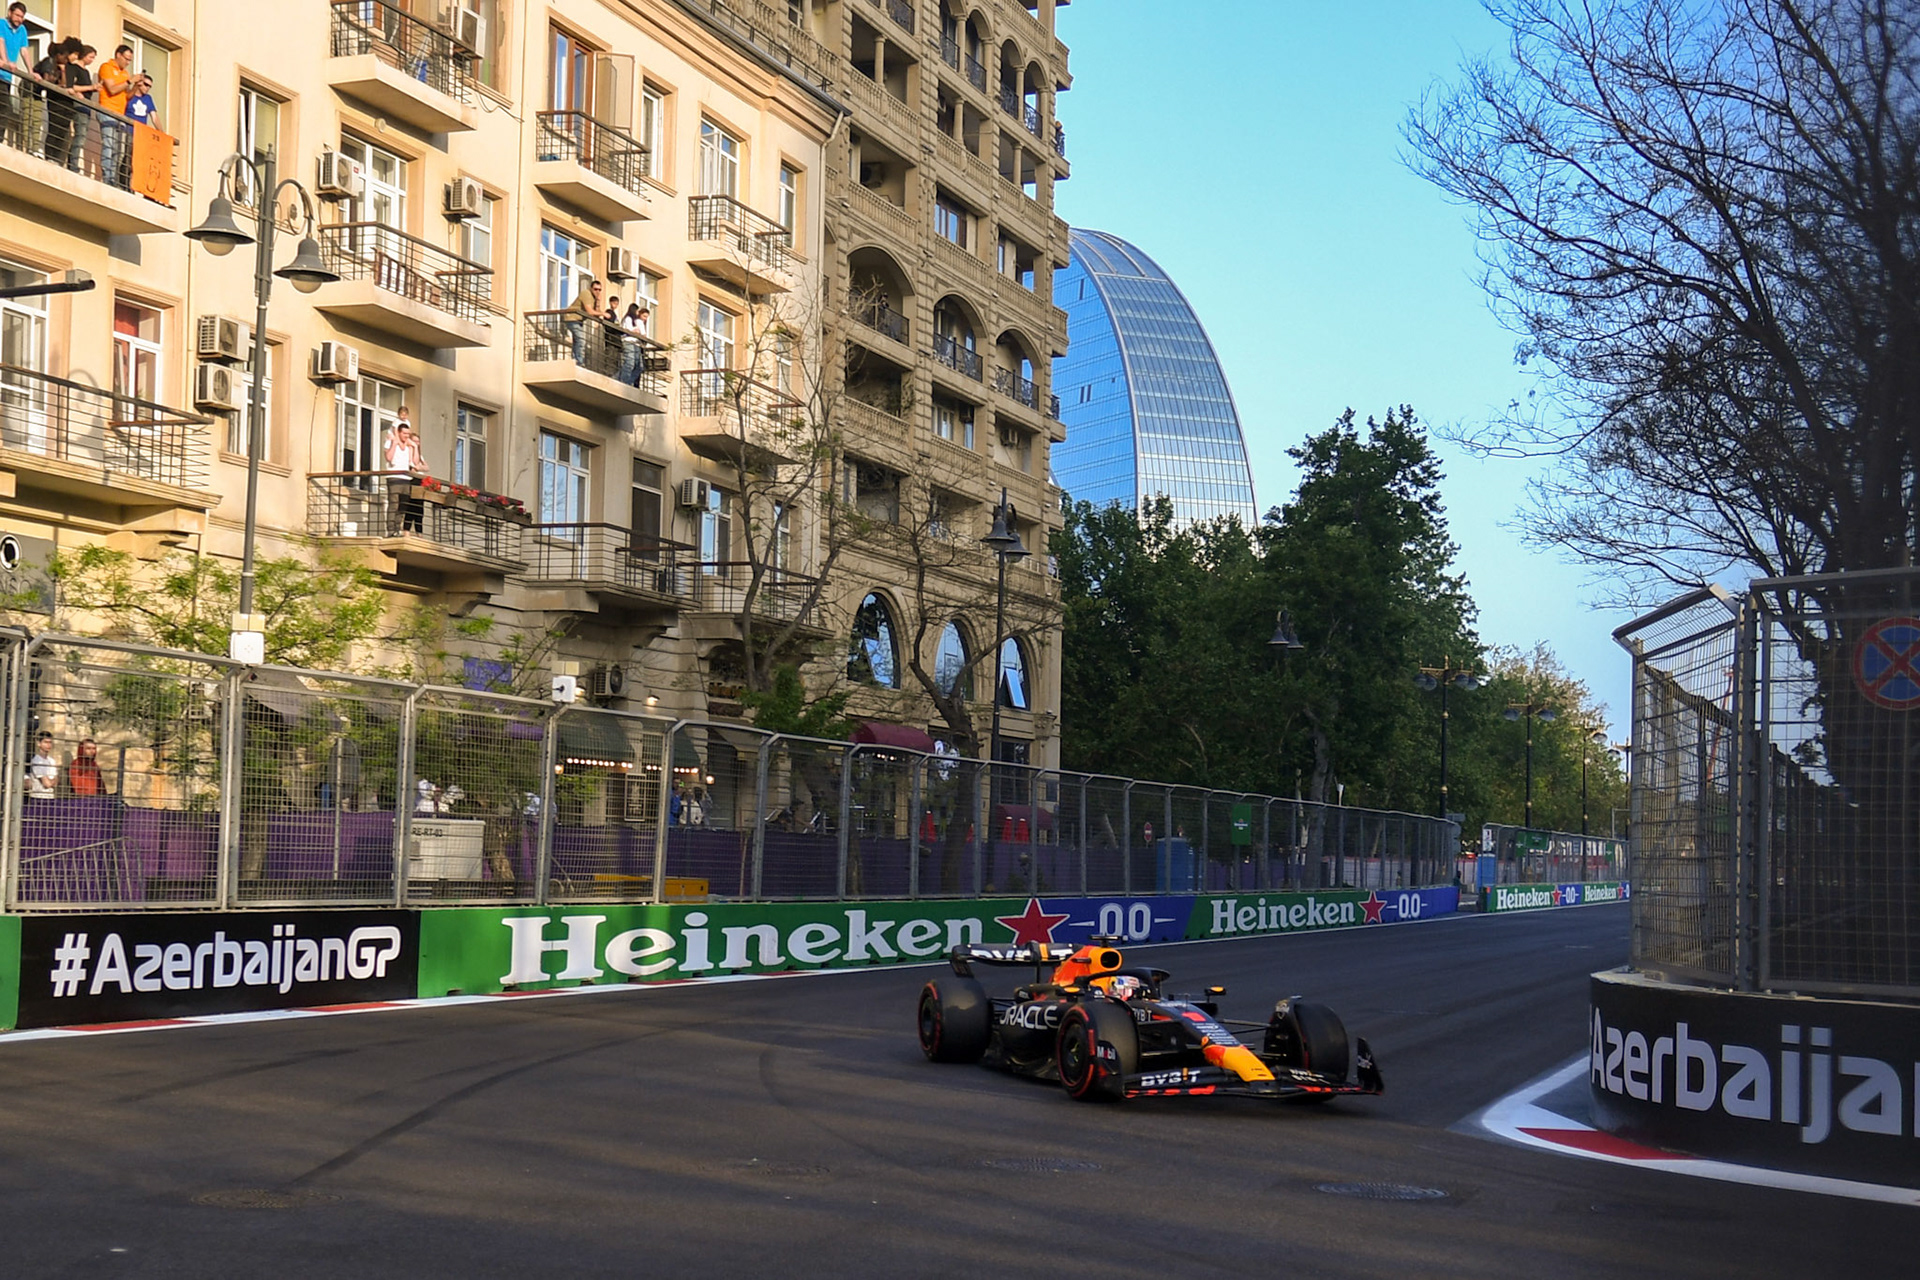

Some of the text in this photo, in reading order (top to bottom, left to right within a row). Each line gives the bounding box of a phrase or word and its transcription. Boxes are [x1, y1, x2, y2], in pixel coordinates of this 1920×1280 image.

[1210, 896, 1355, 934] Heineken
[1496, 887, 1551, 910] Heineken
[1585, 884, 1617, 902] Heineken
[50, 923, 402, 998] #AzerbaijanGP
[500, 909, 983, 985] Heineken
[1589, 1003, 1920, 1144] Azerbaija
